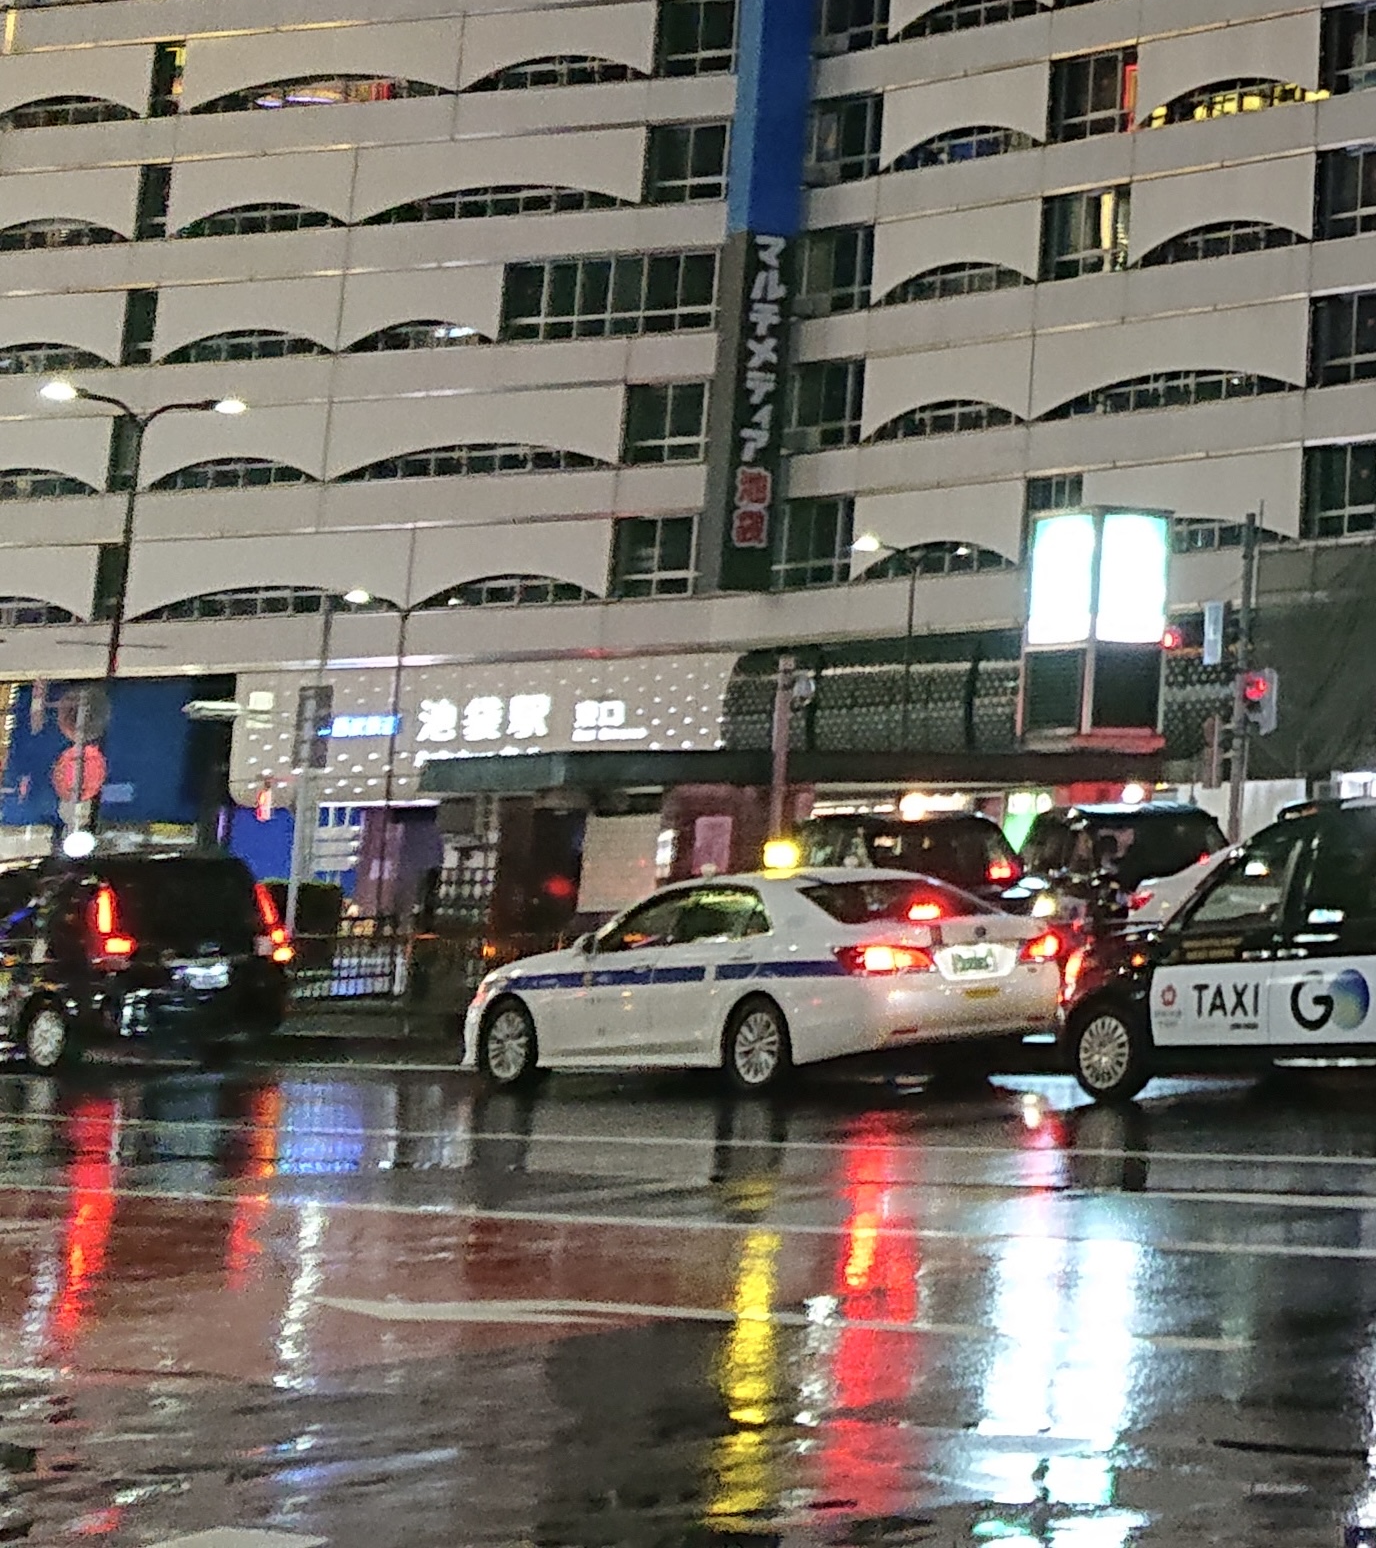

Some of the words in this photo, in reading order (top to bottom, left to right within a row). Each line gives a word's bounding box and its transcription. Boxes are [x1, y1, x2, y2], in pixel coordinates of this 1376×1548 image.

[415, 693, 552, 743] 池袋駅
[1192, 983, 1260, 1018] TAXI
